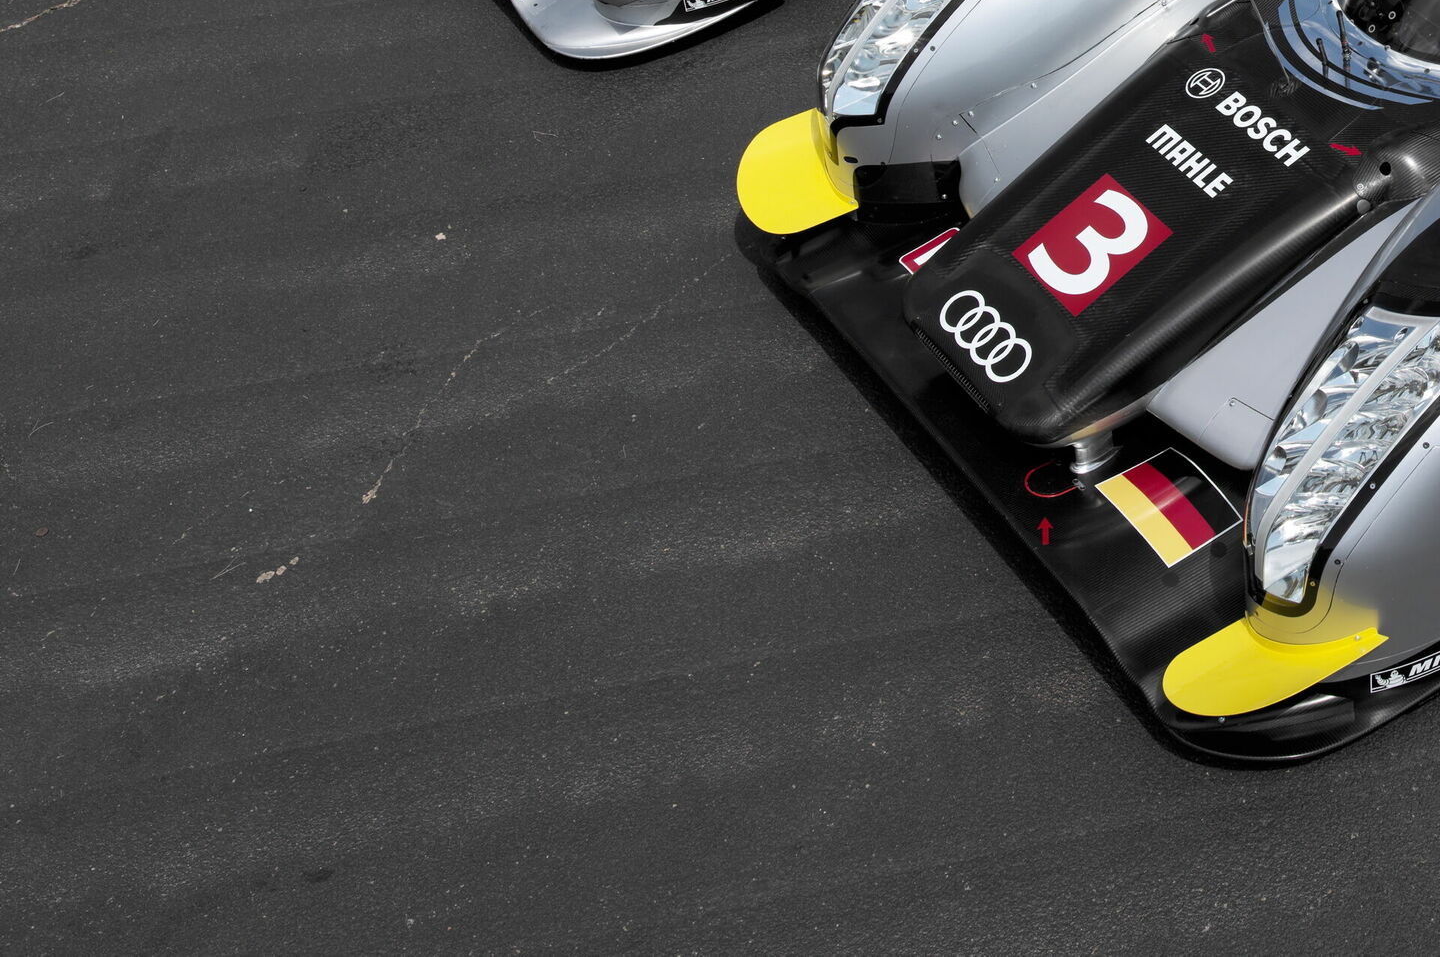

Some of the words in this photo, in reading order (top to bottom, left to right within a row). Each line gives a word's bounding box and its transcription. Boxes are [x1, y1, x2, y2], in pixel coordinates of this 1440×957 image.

[1145, 123, 1235, 199] MAHLE
[1215, 90, 1311, 168] BOSCH
[1027, 189, 1149, 296] 3
